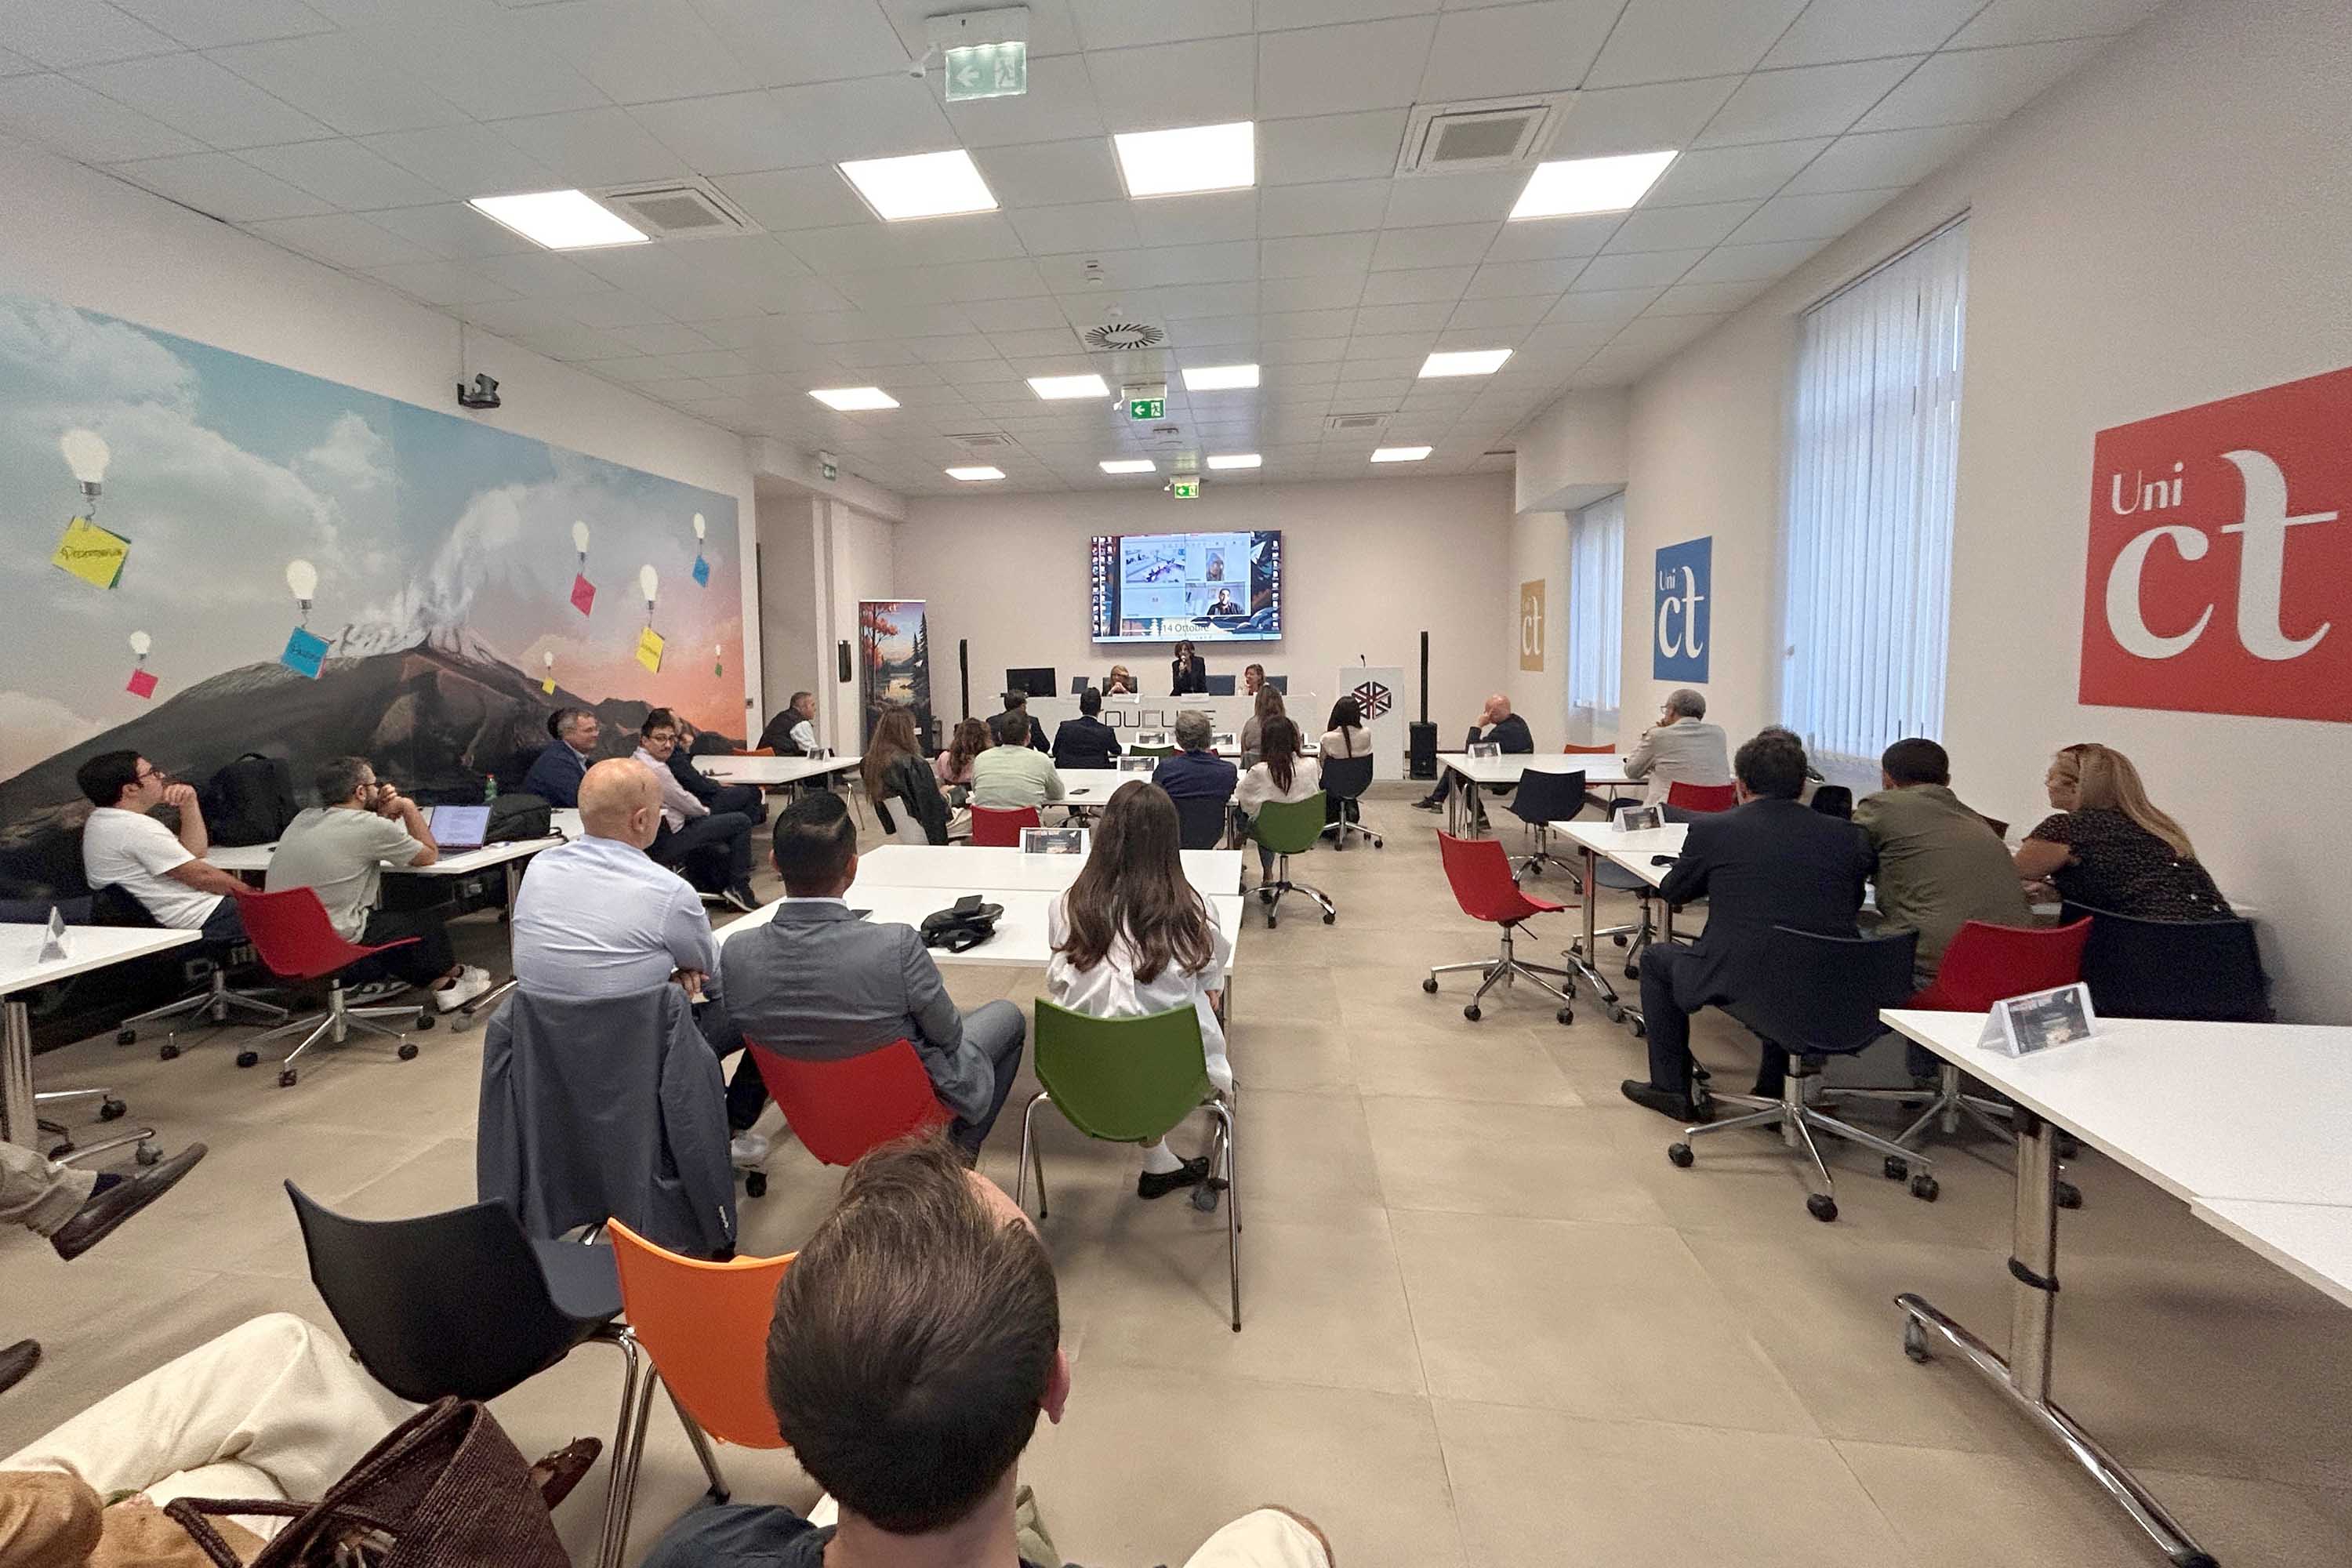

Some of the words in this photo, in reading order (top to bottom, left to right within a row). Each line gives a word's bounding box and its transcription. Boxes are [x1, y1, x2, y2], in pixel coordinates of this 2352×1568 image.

[2111, 461, 2183, 515] Uni
[1659, 568, 1676, 590] Uni
[2106, 449, 2339, 661] ct
[1523, 595, 1542, 655] ct
[1659, 566, 1704, 659] ct
